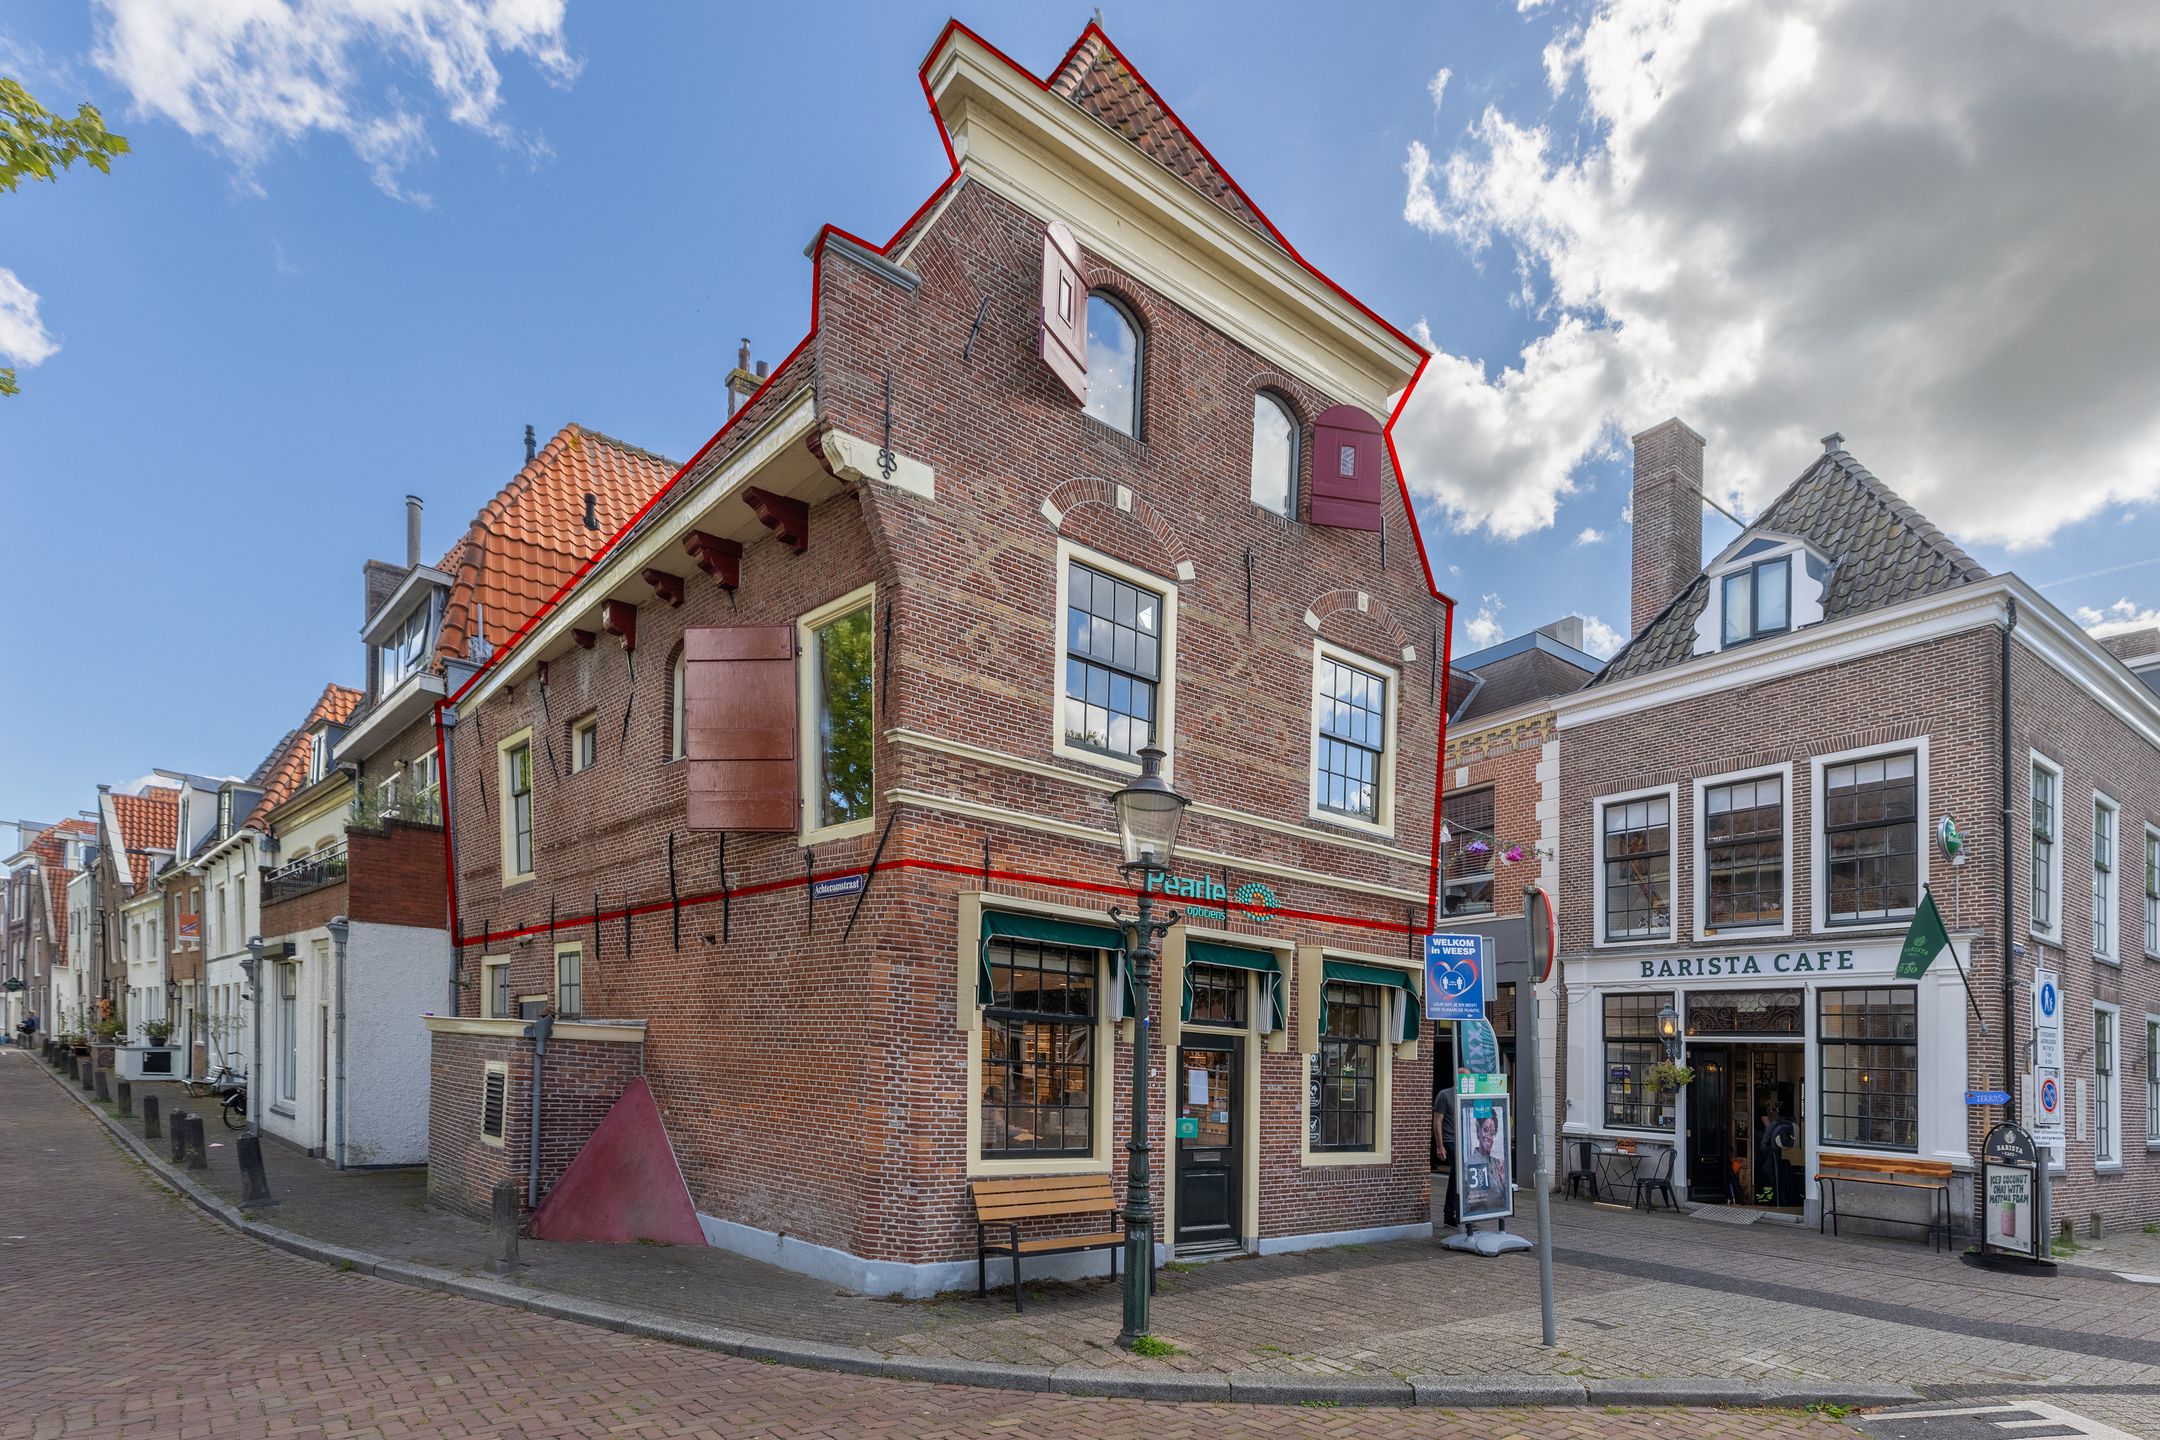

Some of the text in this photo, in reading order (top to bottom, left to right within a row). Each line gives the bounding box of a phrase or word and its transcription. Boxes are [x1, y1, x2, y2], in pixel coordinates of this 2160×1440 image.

[815, 880, 860, 894] Achteromstraat
[1147, 872, 1226, 900] Pearle
[1187, 906, 1226, 920] opticiens
[1432, 938, 1474, 946] WELKOM
[1442, 947, 1476, 955] WEESP
[1640, 950, 1854, 978] BARISTA CAFE
[1996, 1144, 2023, 1155] BARISTA
[1470, 1168, 1478, 1188] 3
[1483, 1166, 1488, 1186] 1
[1990, 1174, 2028, 1184] ICED COCONUT
[1994, 1185, 2024, 1194] CHAI WITH
[2012, 1194, 2029, 1205] FOAM
